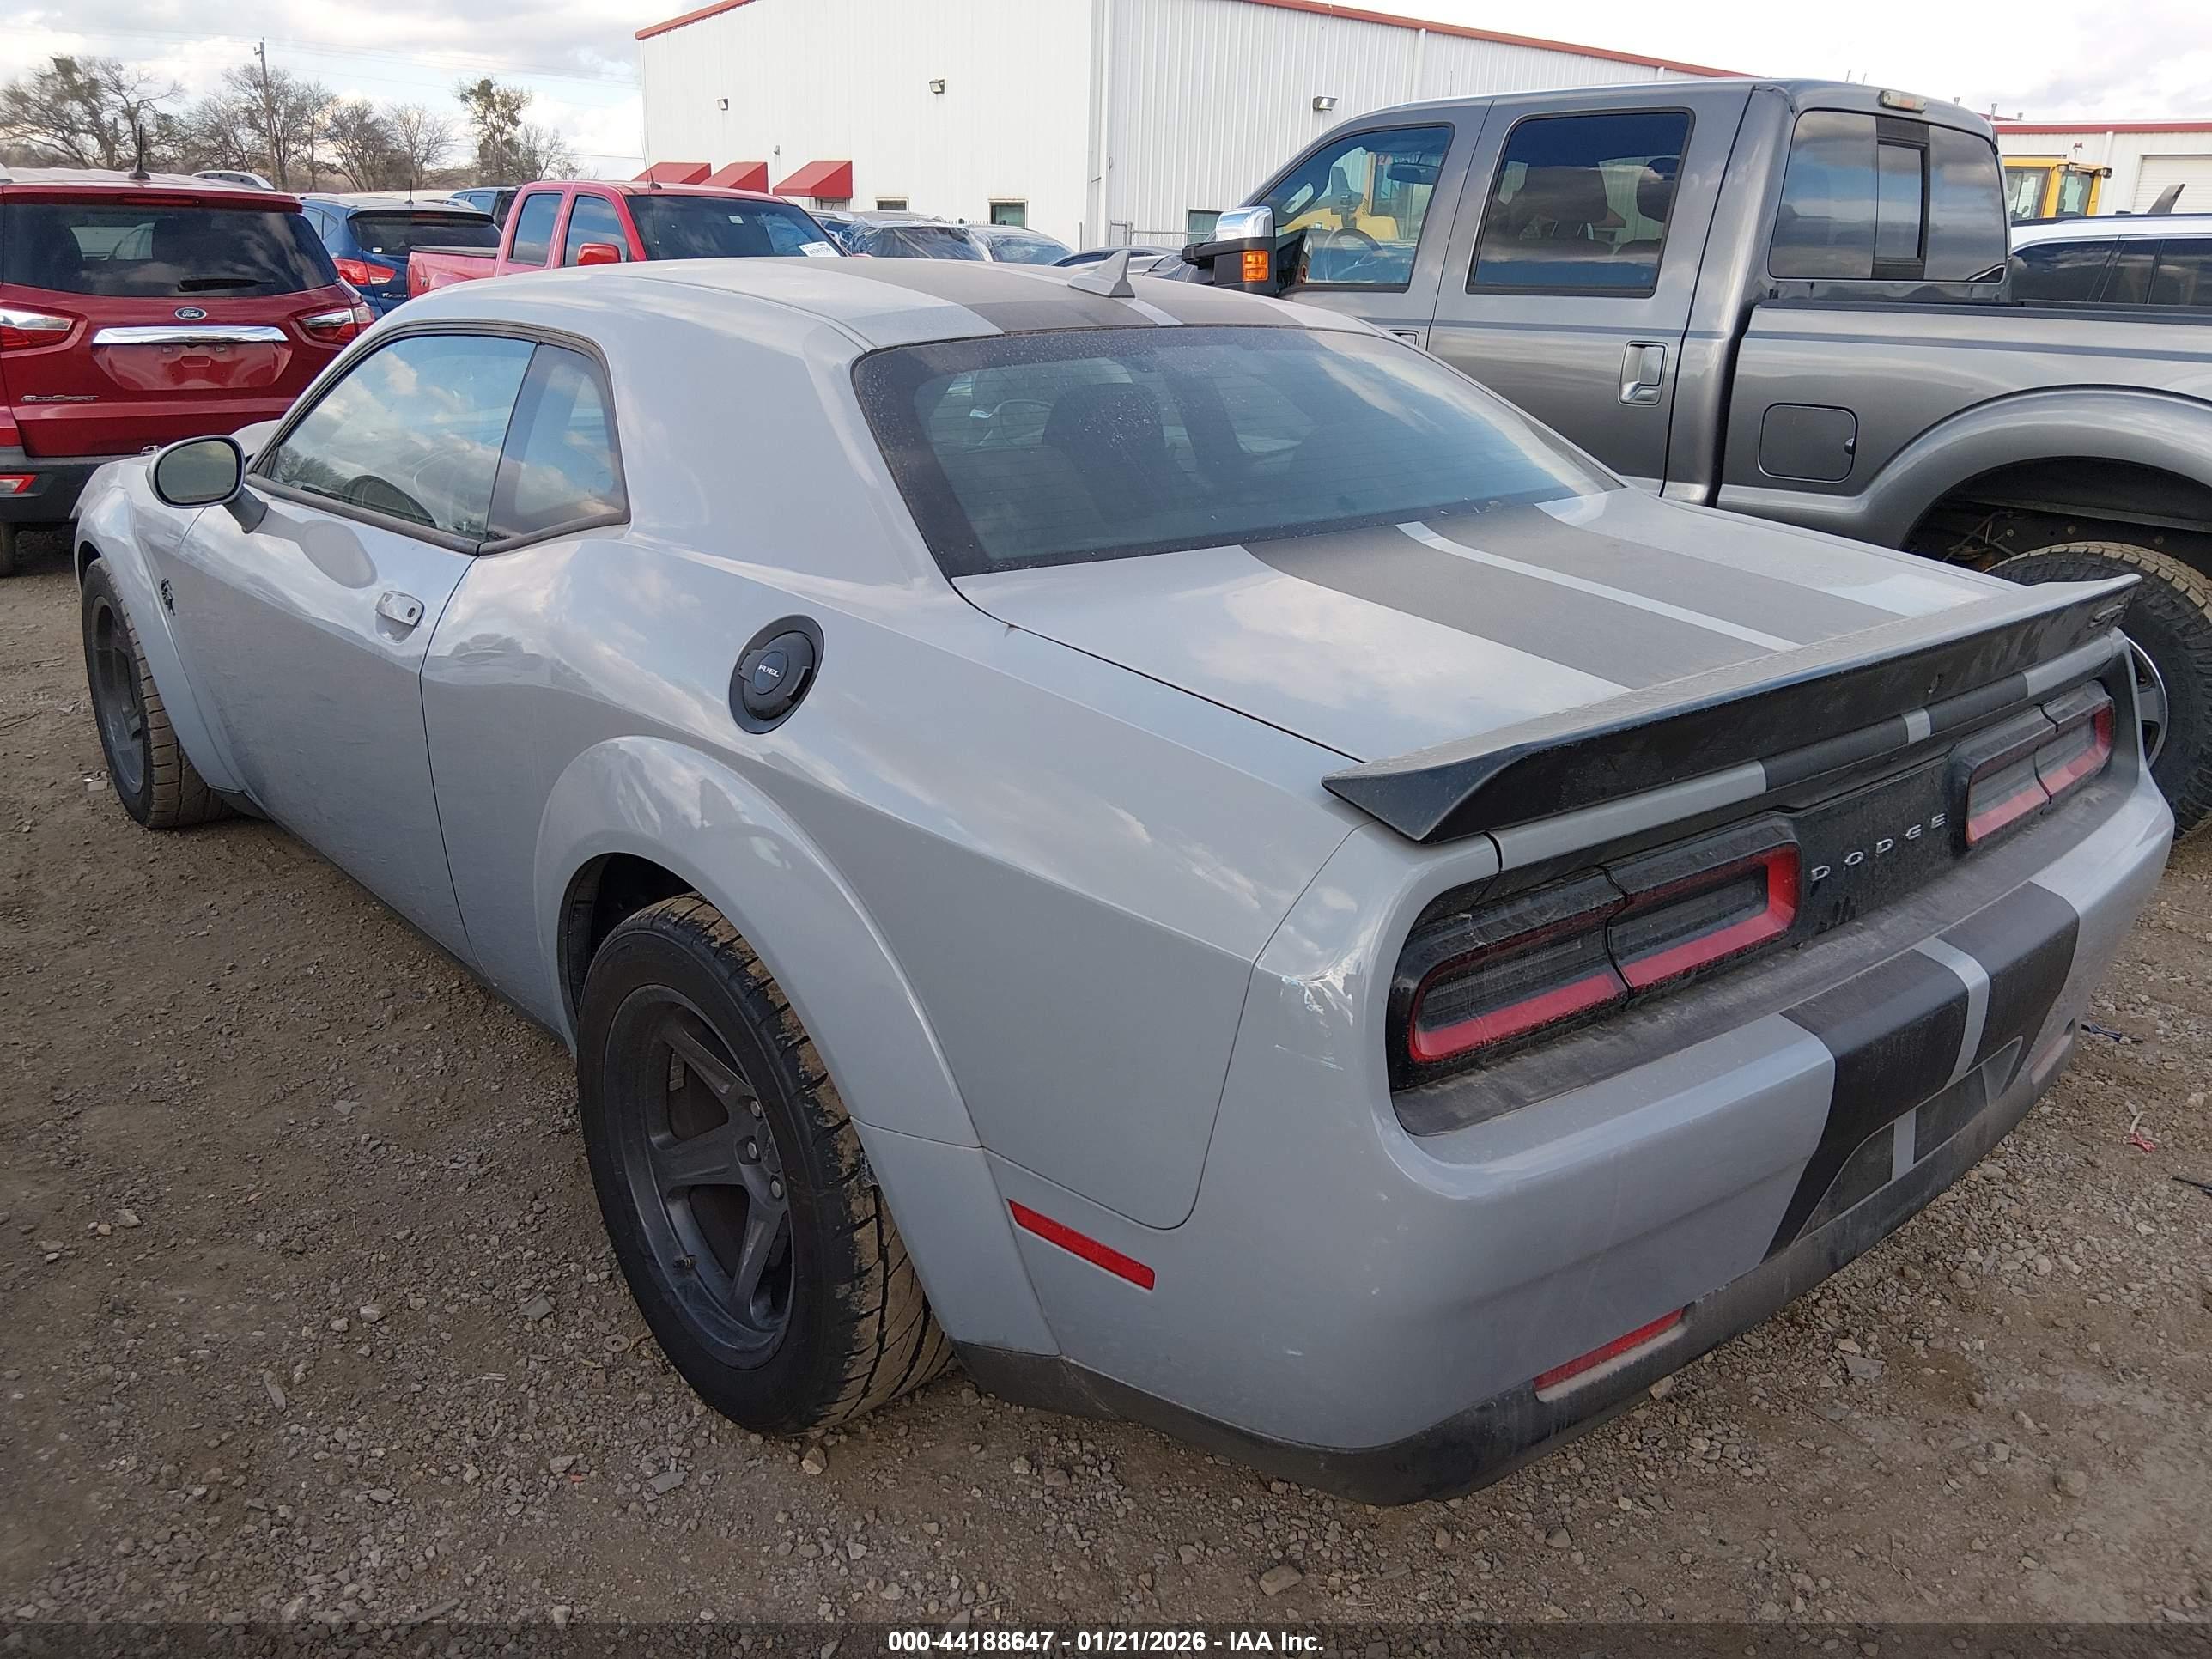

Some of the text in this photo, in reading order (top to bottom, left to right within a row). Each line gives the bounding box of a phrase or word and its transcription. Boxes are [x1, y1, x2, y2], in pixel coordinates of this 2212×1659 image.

[181, 309, 201, 318] Ford
[757, 664, 780, 678] FUEL
[1811, 812, 1947, 882] DODGE
